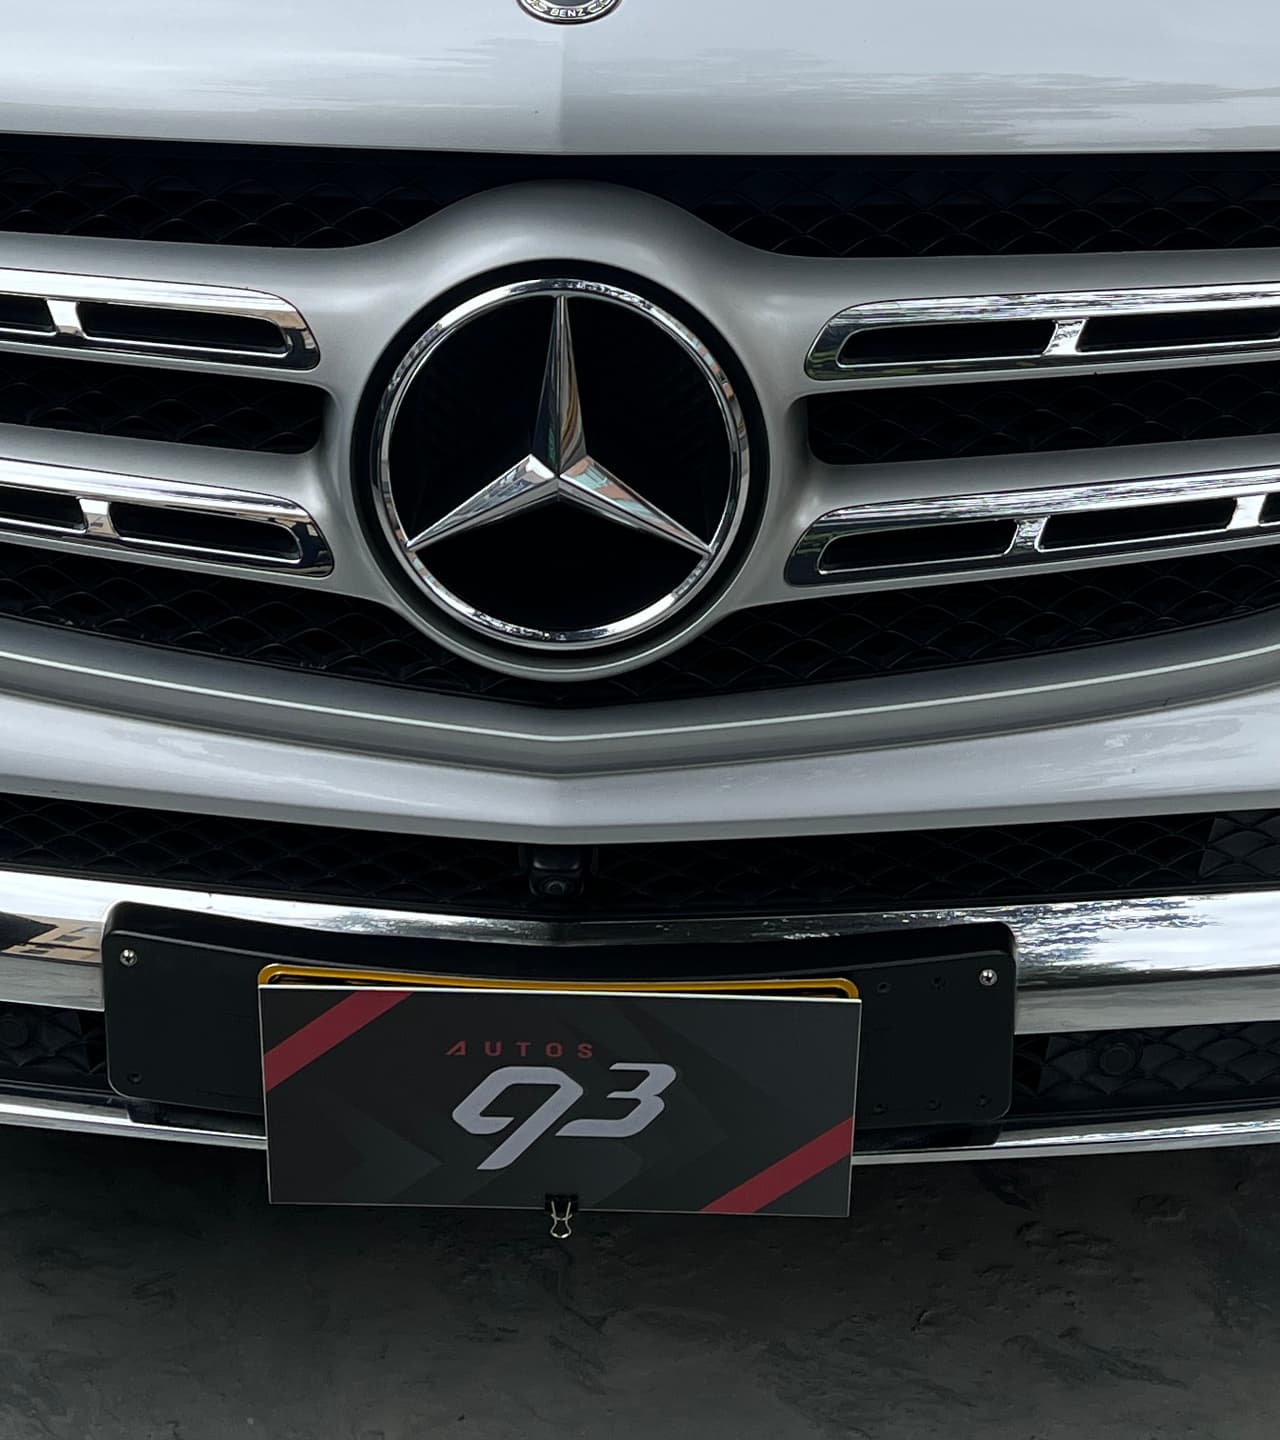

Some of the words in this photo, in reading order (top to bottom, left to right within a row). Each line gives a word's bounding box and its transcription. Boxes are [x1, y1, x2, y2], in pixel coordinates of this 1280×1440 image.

[550, 8, 586, 17] BENZ
[445, 1040, 593, 1058] AUTOS
[451, 1062, 677, 1171] 93
